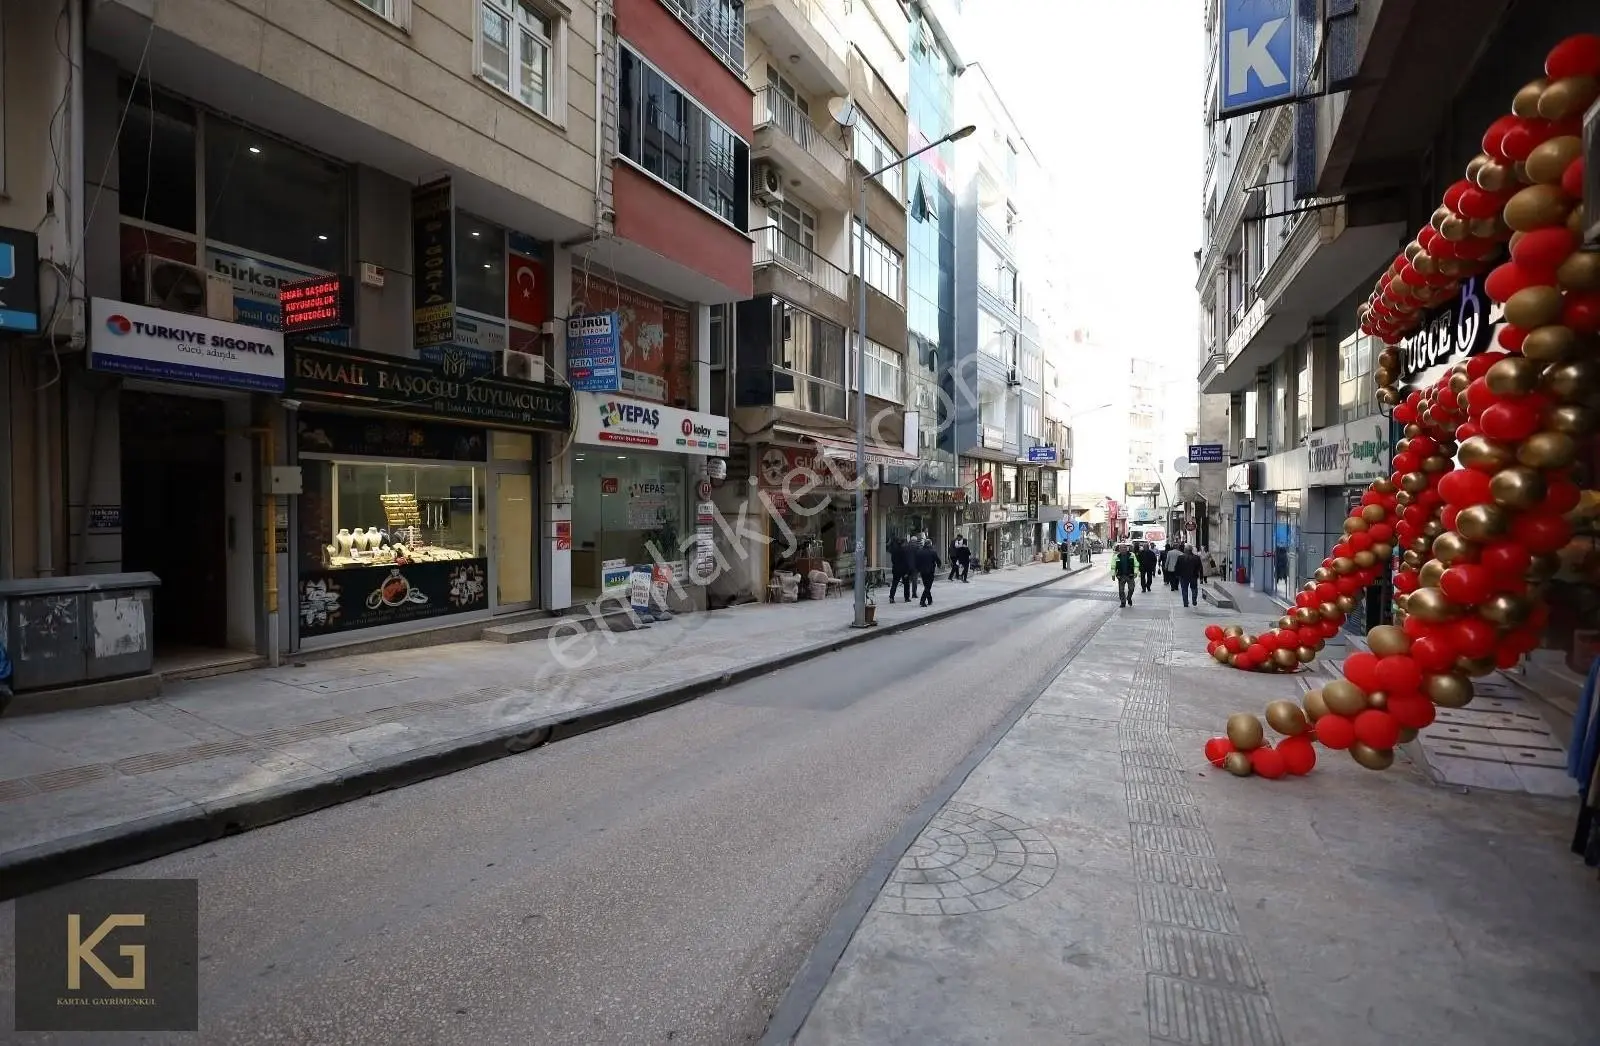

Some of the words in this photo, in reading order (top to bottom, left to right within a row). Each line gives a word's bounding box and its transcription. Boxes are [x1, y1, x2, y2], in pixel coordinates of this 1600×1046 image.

[1227, 16, 1289, 97] K
[294, 352, 369, 388] İSMAİL
[377, 368, 460, 398] BAŞOĞLU
[465, 385, 565, 415] KUYUMCULUK
[617, 403, 660, 430] YEPAŞ
[693, 424, 711, 438] kolay
